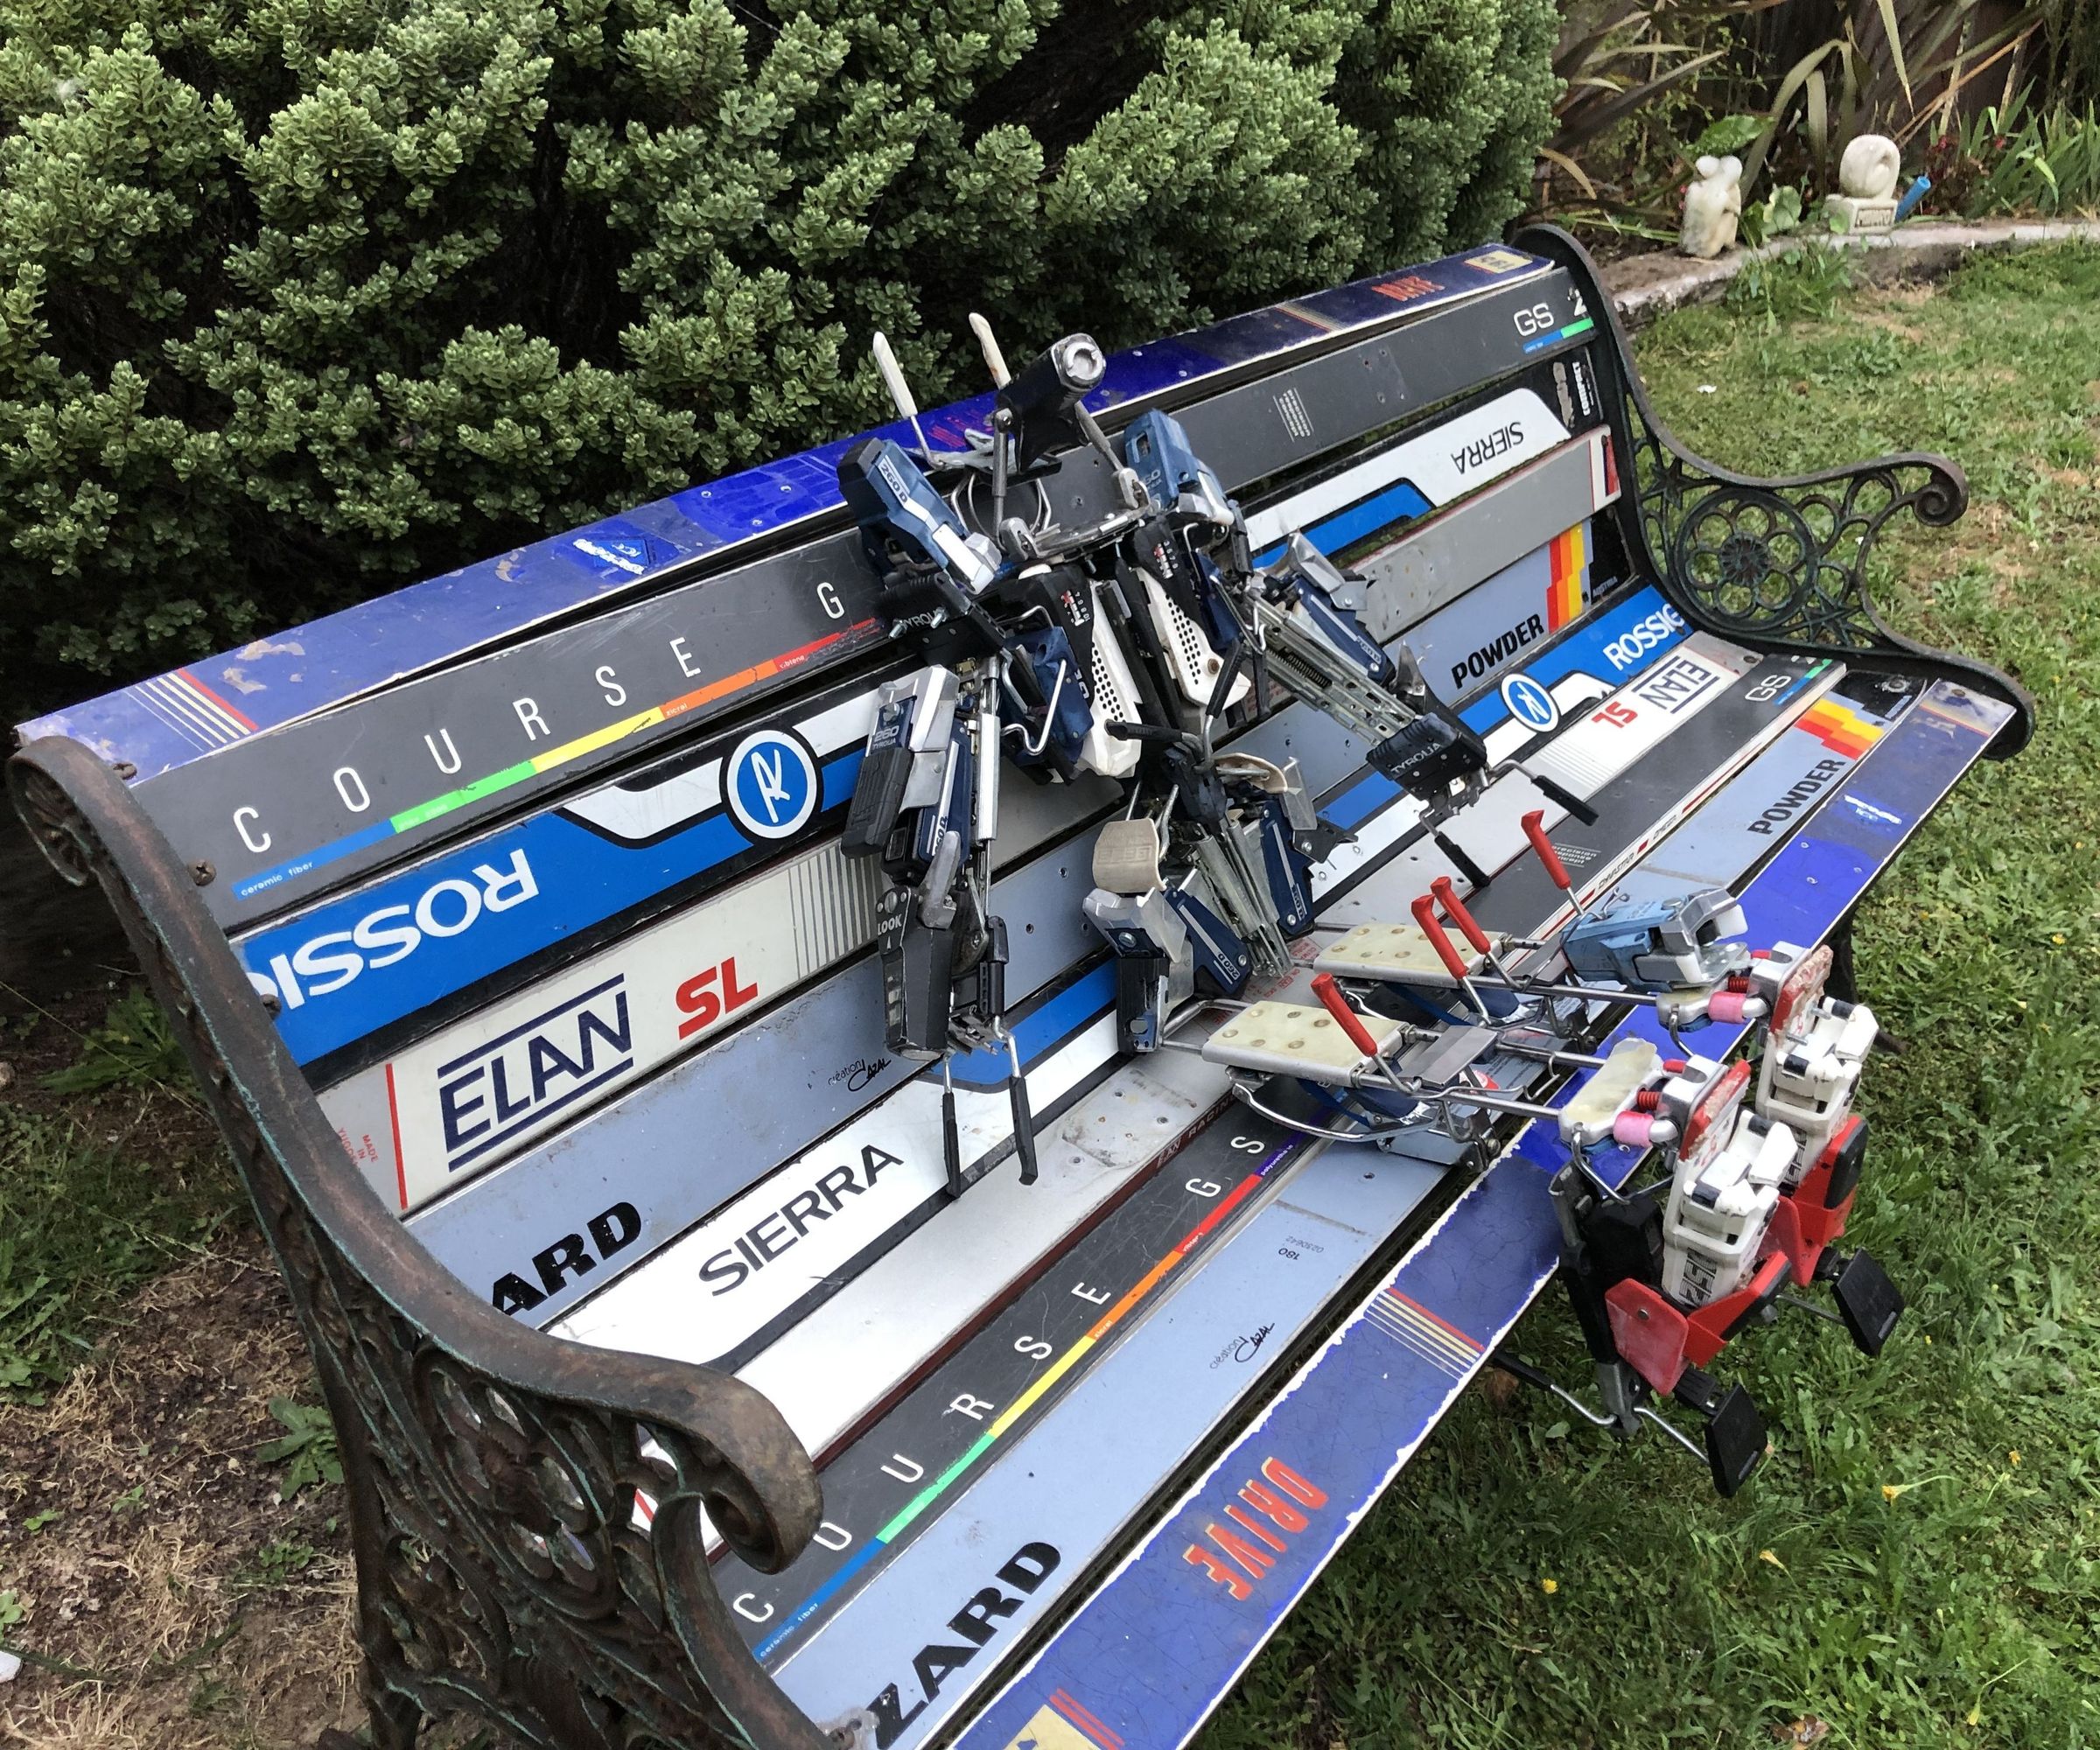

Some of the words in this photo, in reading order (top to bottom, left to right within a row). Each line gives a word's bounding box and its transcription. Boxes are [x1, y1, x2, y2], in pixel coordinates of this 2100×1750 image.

[1513, 302, 1554, 336] GS
[1450, 421, 1523, 474] SIERRA
[880, 463, 900, 491] 260
[1452, 613, 1544, 690] POWDER
[1639, 660, 1712, 710] ELAN
[1745, 674, 1792, 703] GS
[1591, 700, 1639, 728] SL
[875, 725, 900, 742] 260
[1390, 742, 1443, 774] TYROLIA
[1746, 758, 1846, 836] POWDER
[240, 873, 283, 897] ceramic
[288, 861, 313, 877] fiber
[877, 914, 902, 935] LOOK
[675, 956, 759, 1040] SL
[438, 990, 633, 1152] ELAN
[357, 1149, 366, 1159] IN
[362, 1134, 378, 1162] MADE
[697, 1144, 904, 1297] SIERRA
[1278, 1247, 1301, 1261] 180
[1182, 1456, 1329, 1600] DRIVE
[867, 1541, 1061, 1749] ZARD
